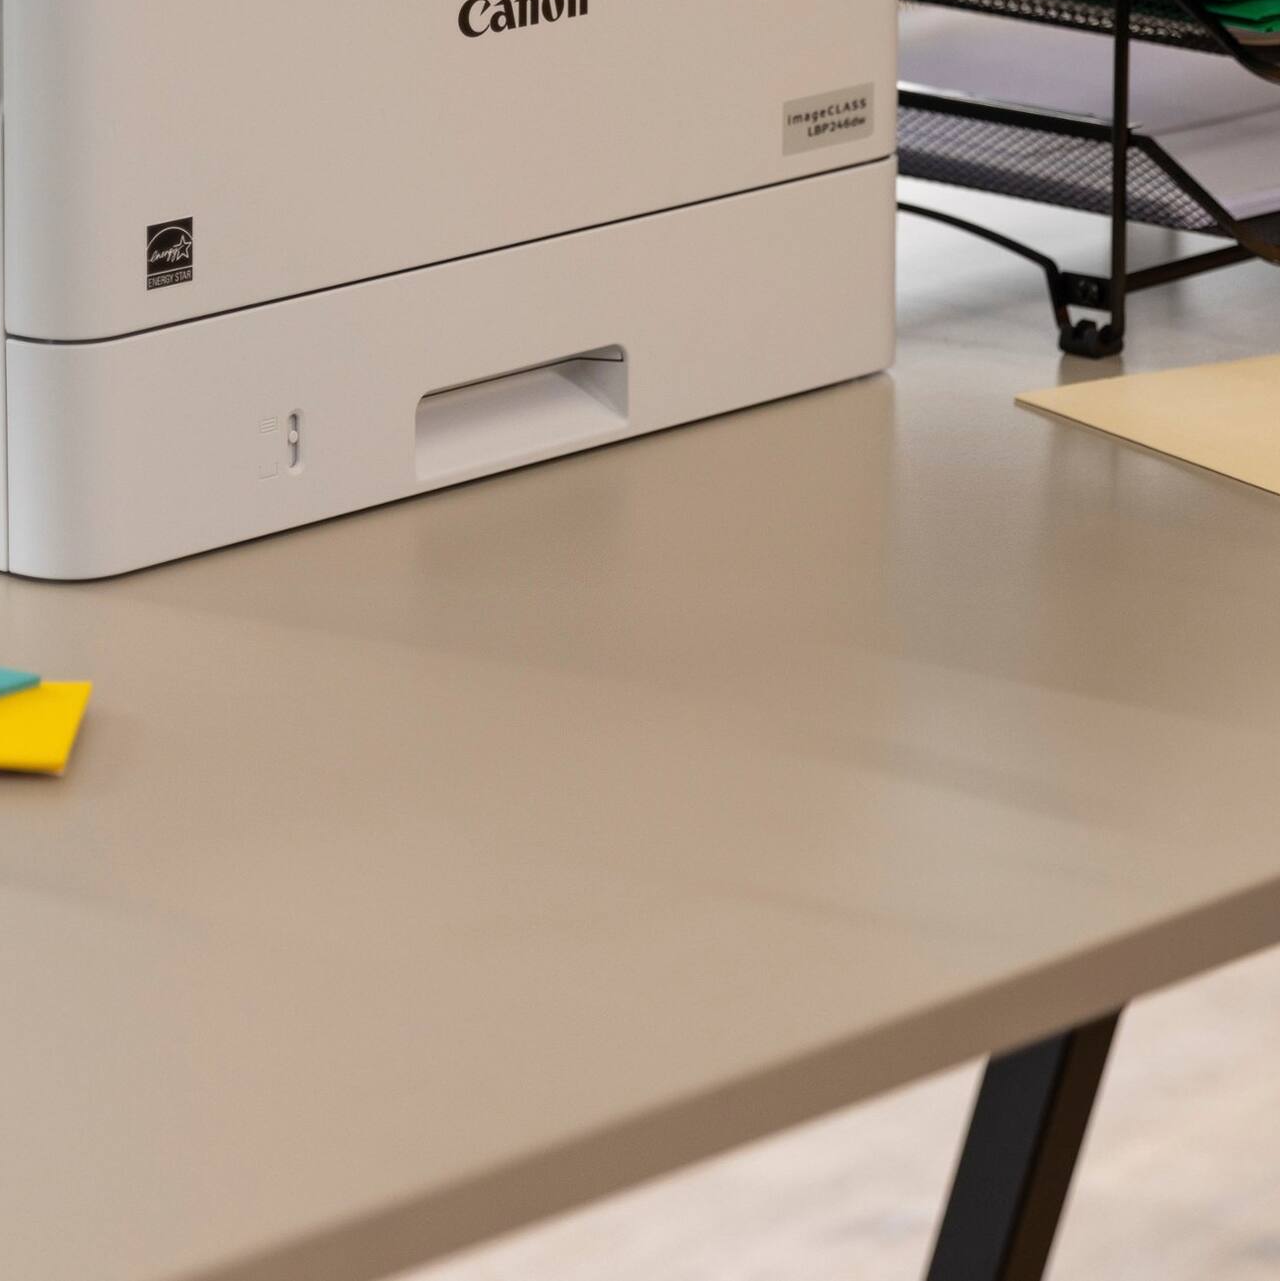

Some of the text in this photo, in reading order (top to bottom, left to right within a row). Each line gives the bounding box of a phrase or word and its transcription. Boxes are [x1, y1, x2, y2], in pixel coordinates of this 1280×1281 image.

[786, 98, 868, 126] imageCLASS
[148, 271, 191, 288] ENERGY STAR
